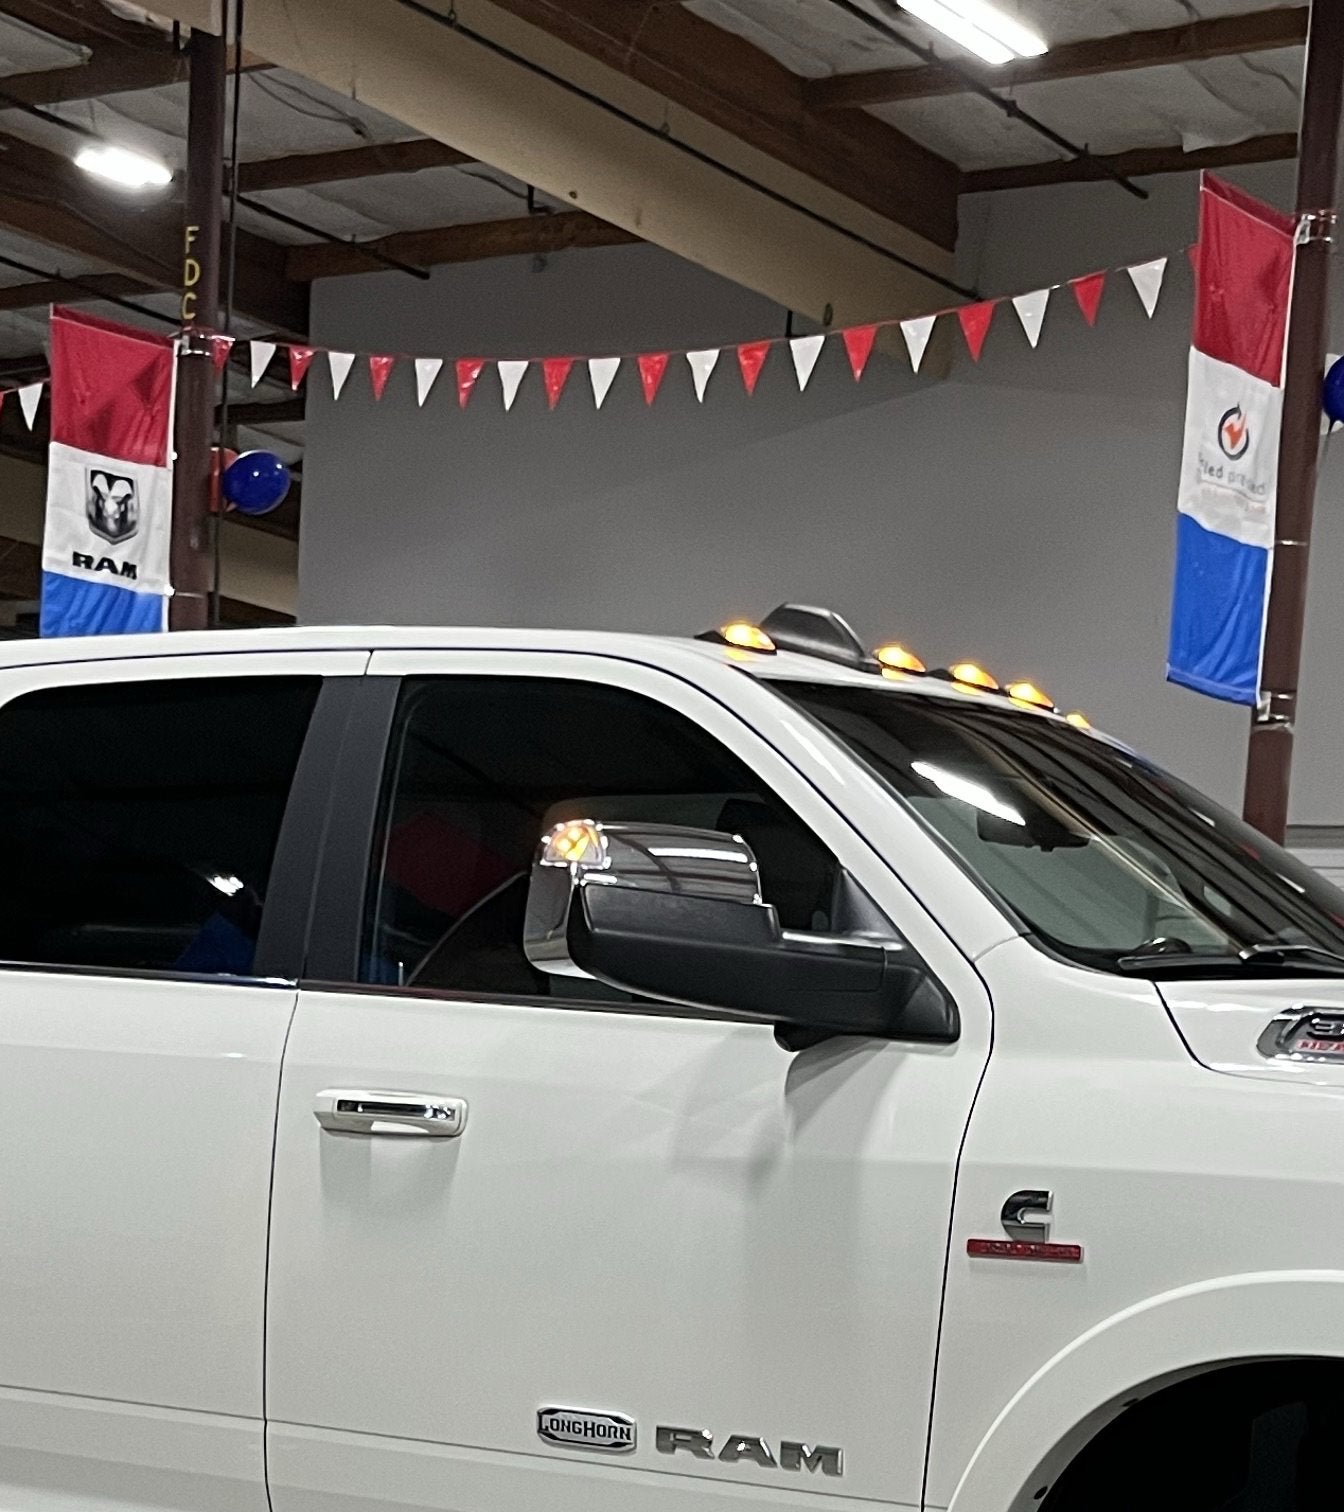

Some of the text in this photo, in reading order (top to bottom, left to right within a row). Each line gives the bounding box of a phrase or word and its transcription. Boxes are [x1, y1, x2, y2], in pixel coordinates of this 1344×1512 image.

[72, 551, 138, 580] RAM
[537, 1415, 633, 1442] LONGHORN
[655, 1425, 844, 1477] RAM
